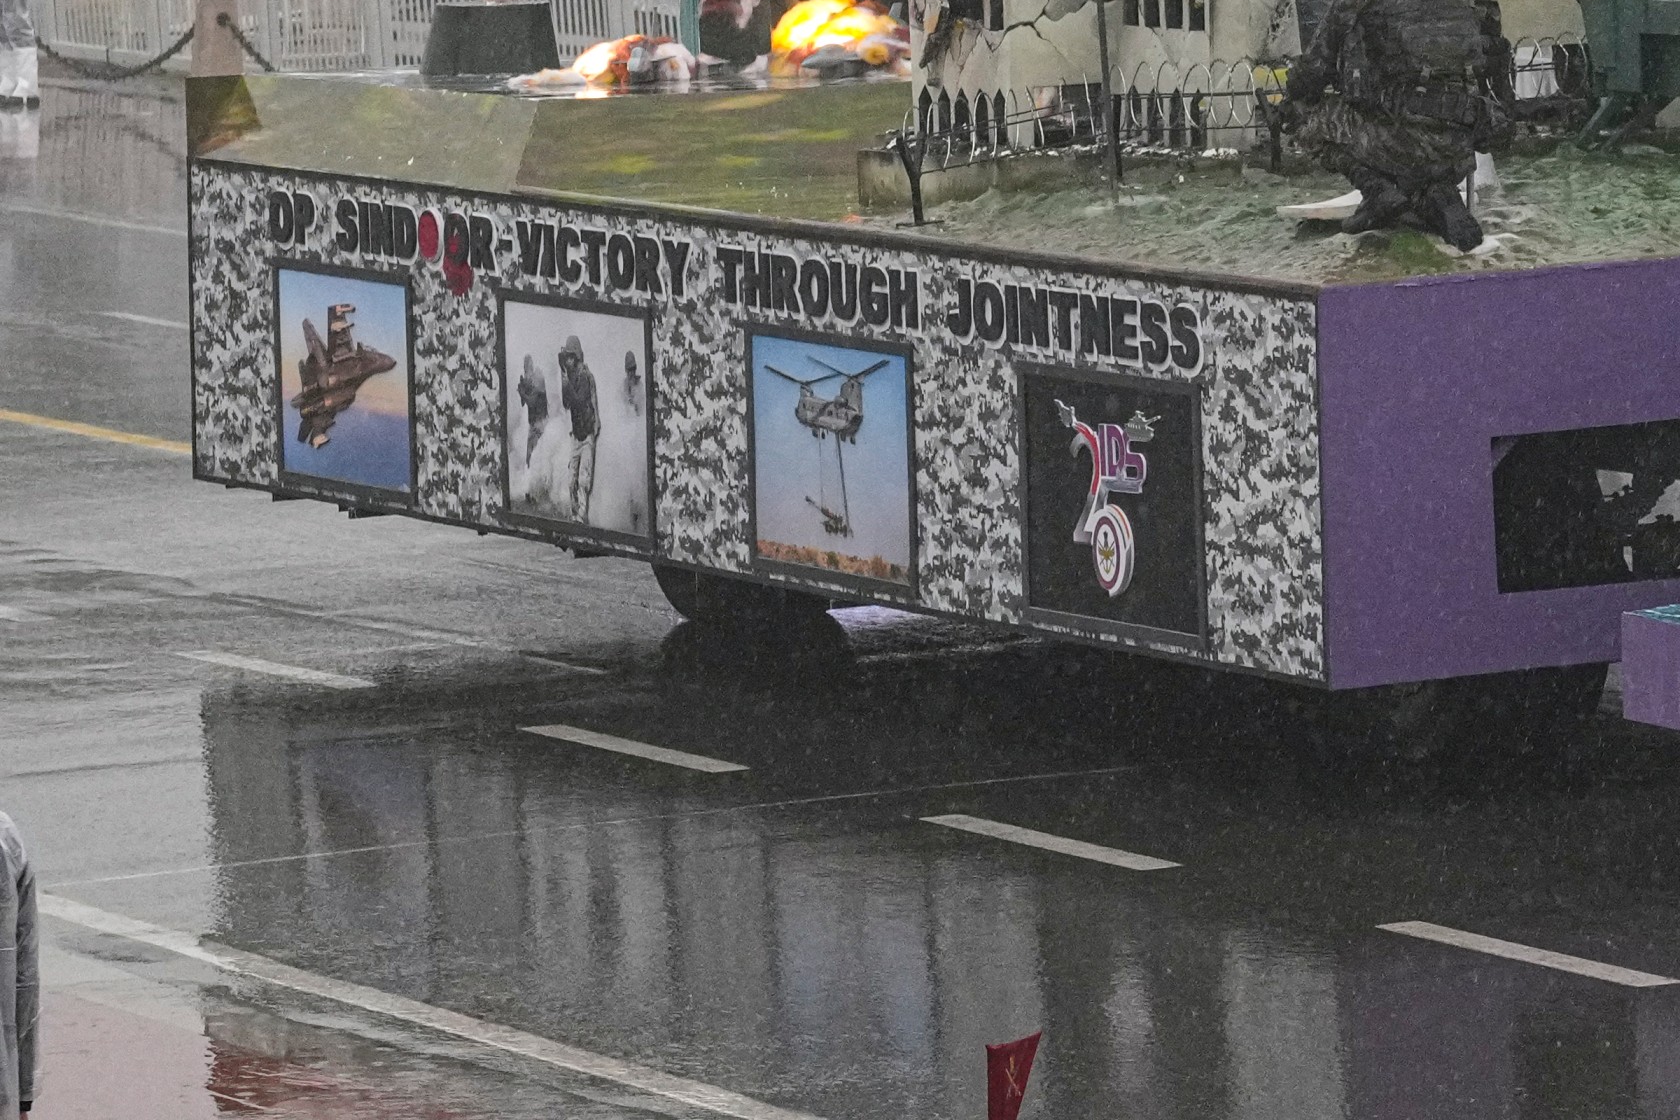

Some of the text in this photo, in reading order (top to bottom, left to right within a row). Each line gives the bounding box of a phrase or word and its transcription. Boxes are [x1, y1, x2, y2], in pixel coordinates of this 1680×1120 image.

[267, 187, 317, 251] OP
[715, 243, 923, 337] THROUGH
[947, 276, 1204, 378] JOINTNESS
